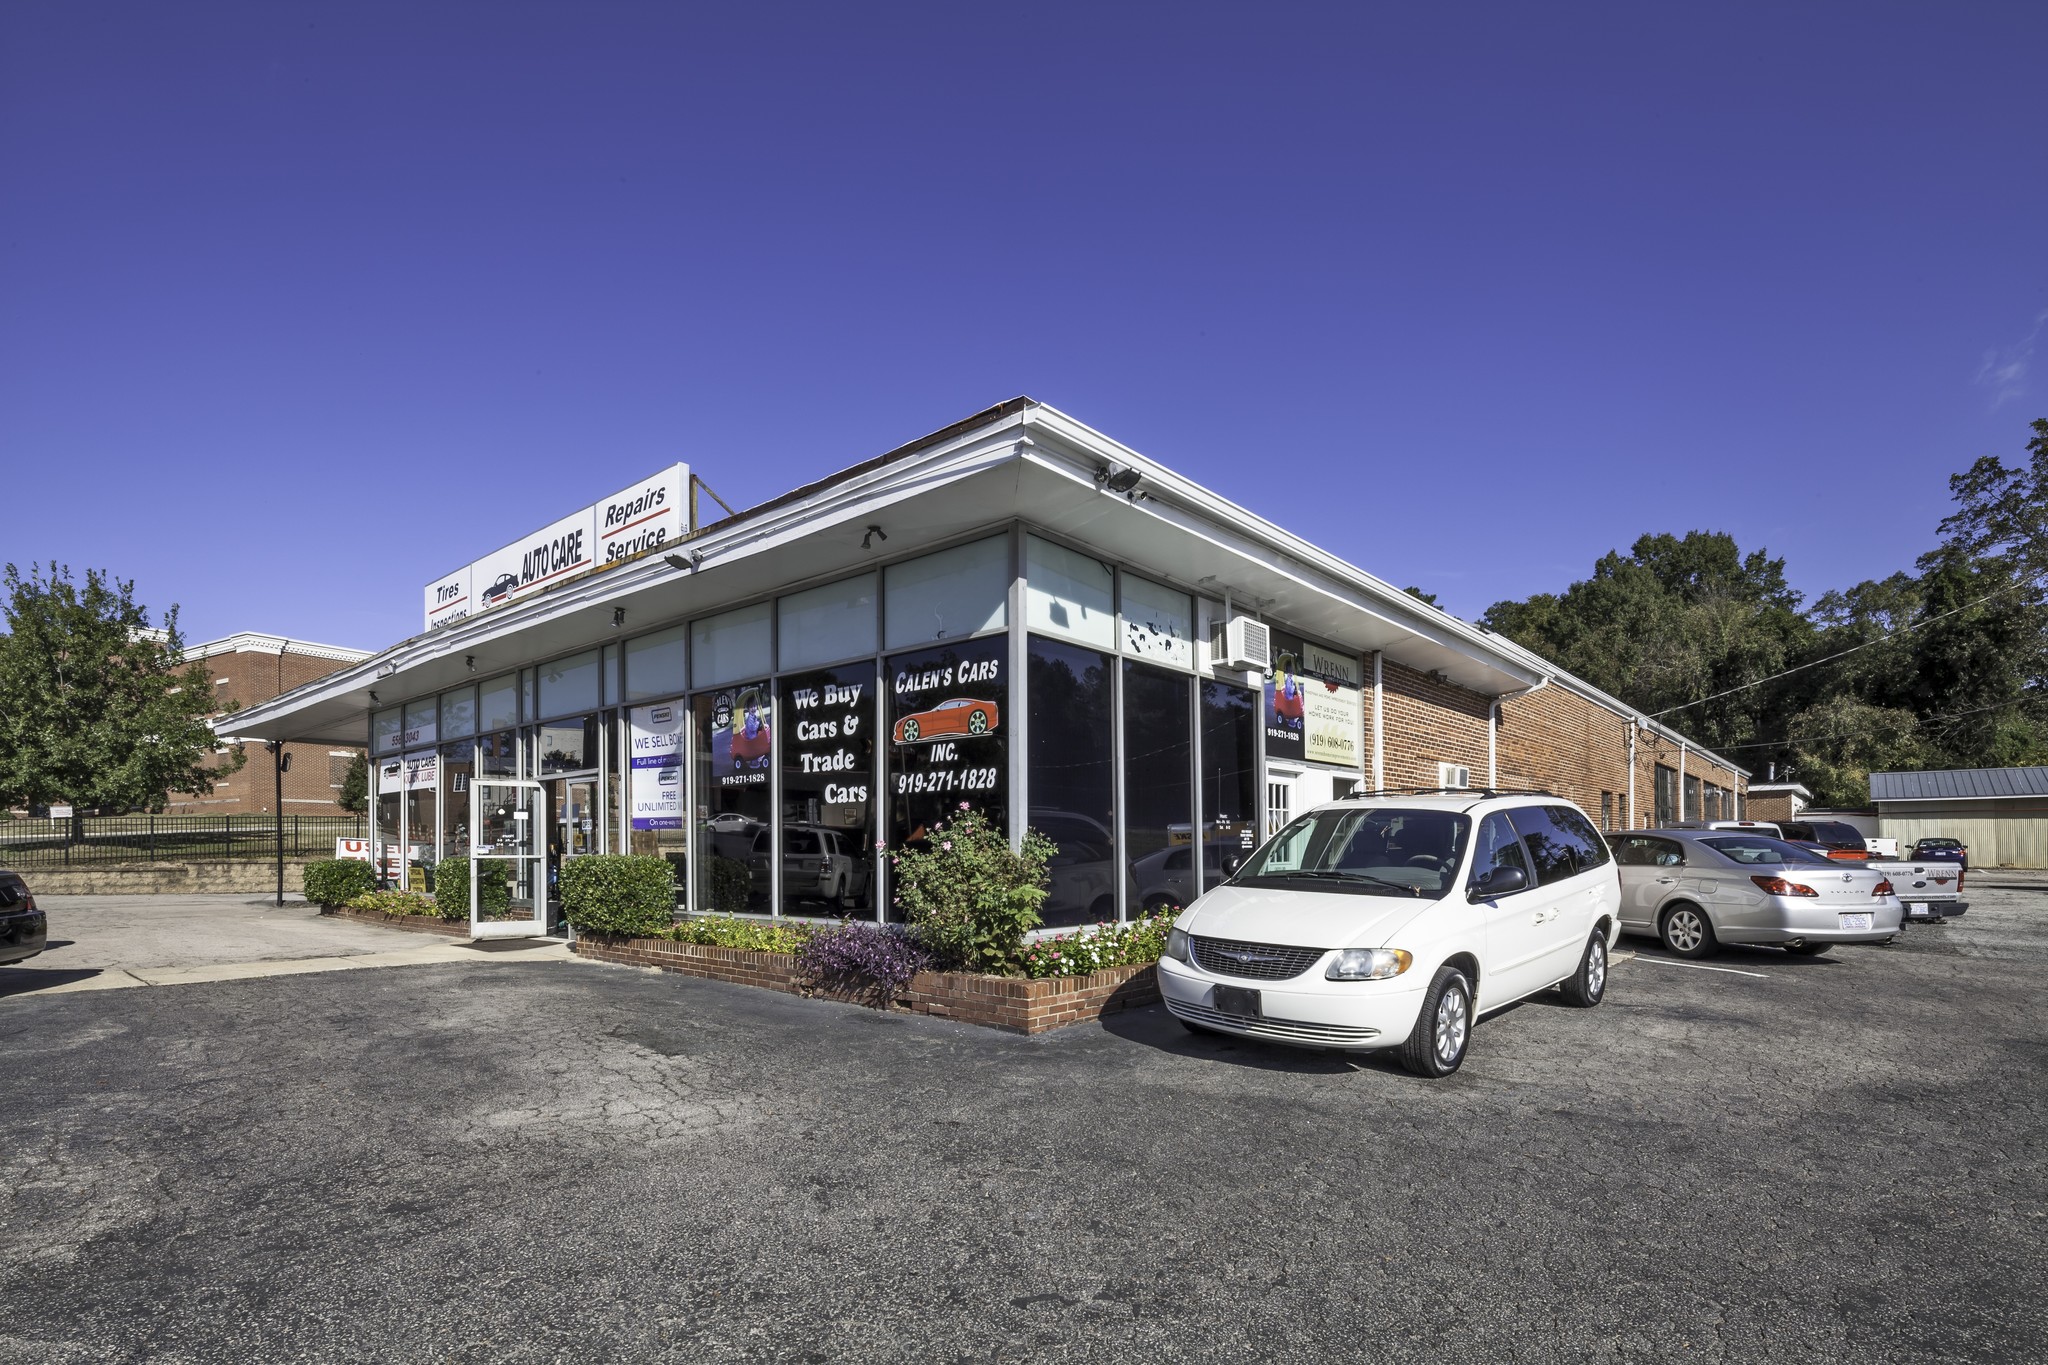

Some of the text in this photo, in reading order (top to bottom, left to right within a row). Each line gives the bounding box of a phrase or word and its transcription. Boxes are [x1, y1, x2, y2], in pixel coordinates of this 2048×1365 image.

[605, 487, 666, 528] Repairs
[605, 528, 666, 563] Service
[521, 528, 583, 585] AUTO CARE
[436, 582, 459, 604] Tires
[895, 659, 999, 694] CALEN'S CARS
[1313, 654, 1349, 681] WRENN
[793, 684, 863, 710] We Buy
[797, 715, 859, 741] Cars &
[634, 737, 650, 749] WE
[651, 735, 669, 748] SELL
[930, 742, 958, 762] INC.
[406, 755, 436, 771] AUTO CARE
[636, 758, 647, 766] Full
[647, 757, 657, 765] line
[800, 748, 855, 773] Trade
[421, 771, 435, 782] LUBE
[722, 773, 765, 785] 919-271-1828
[898, 768, 997, 794] 919-271-1828
[662, 790, 677, 800] FREE
[824, 783, 868, 804] Cars
[637, 801, 677, 812] UNLIMITED
[649, 818, 658, 826] On
[1927, 869, 1957, 878] WRENN
